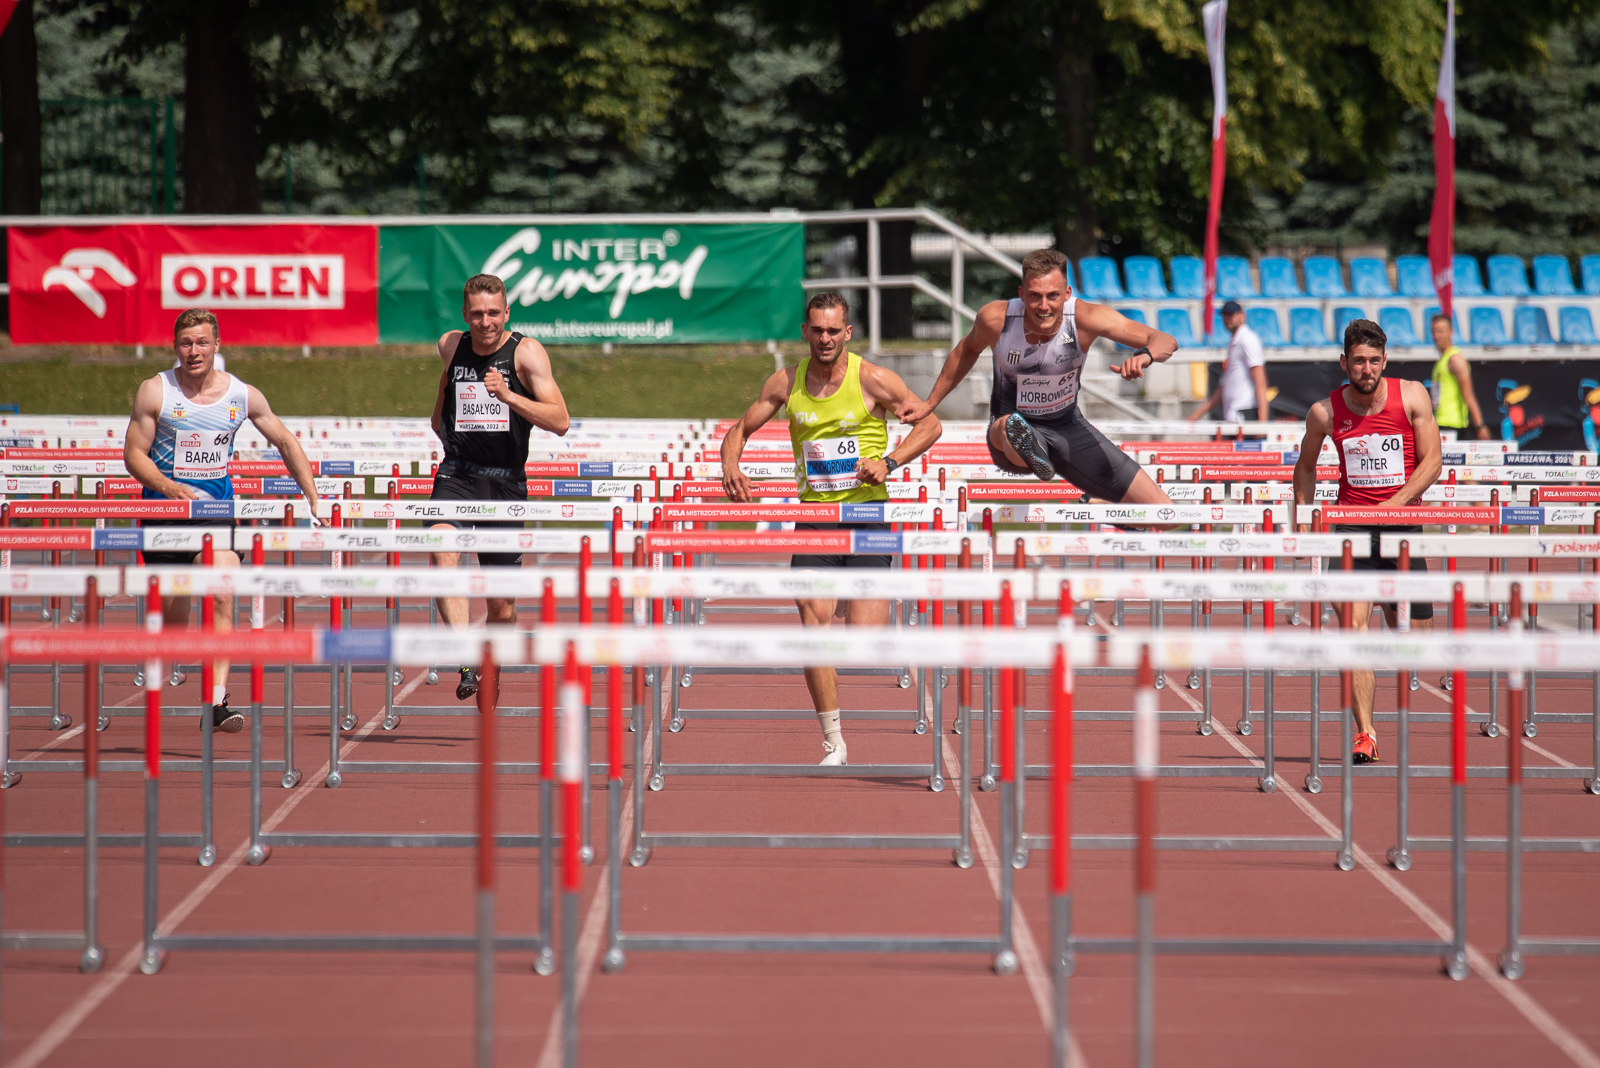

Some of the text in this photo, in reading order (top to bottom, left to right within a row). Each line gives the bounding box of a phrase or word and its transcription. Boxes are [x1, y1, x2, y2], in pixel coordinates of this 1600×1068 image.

[552, 238, 667, 262] INTER
[174, 265, 330, 299] ORLEN
[1058, 372, 1075, 386] 69
[1020, 384, 1073, 403] HORBOWICZ
[463, 404, 501, 415] BASAŁYGO
[214, 433, 229, 446] 66
[1381, 438, 1400, 452] 60
[838, 440, 856, 455] 68
[185, 451, 221, 464] BARAN
[12, 464, 45, 472] TOTALbet
[808, 459, 857, 475] CHOCHOROWSK
[1360, 458, 1388, 471] PITER
[1545, 470, 1577, 478] TOTALbet
[811, 482, 838, 490] WARSZAWA
[241, 503, 274, 516] Europol
[415, 508, 444, 516] FUEL
[456, 505, 496, 514] TOTALbet
[1105, 509, 1146, 518] TOTALbet
[1066, 512, 1094, 520] FUEL
[1551, 510, 1584, 522] Europol
[348, 538, 381, 546] FUEL
[395, 534, 442, 544] TOTALbet
[1160, 539, 1207, 549] TOTALbet
[1112, 542, 1146, 551] FUEL
